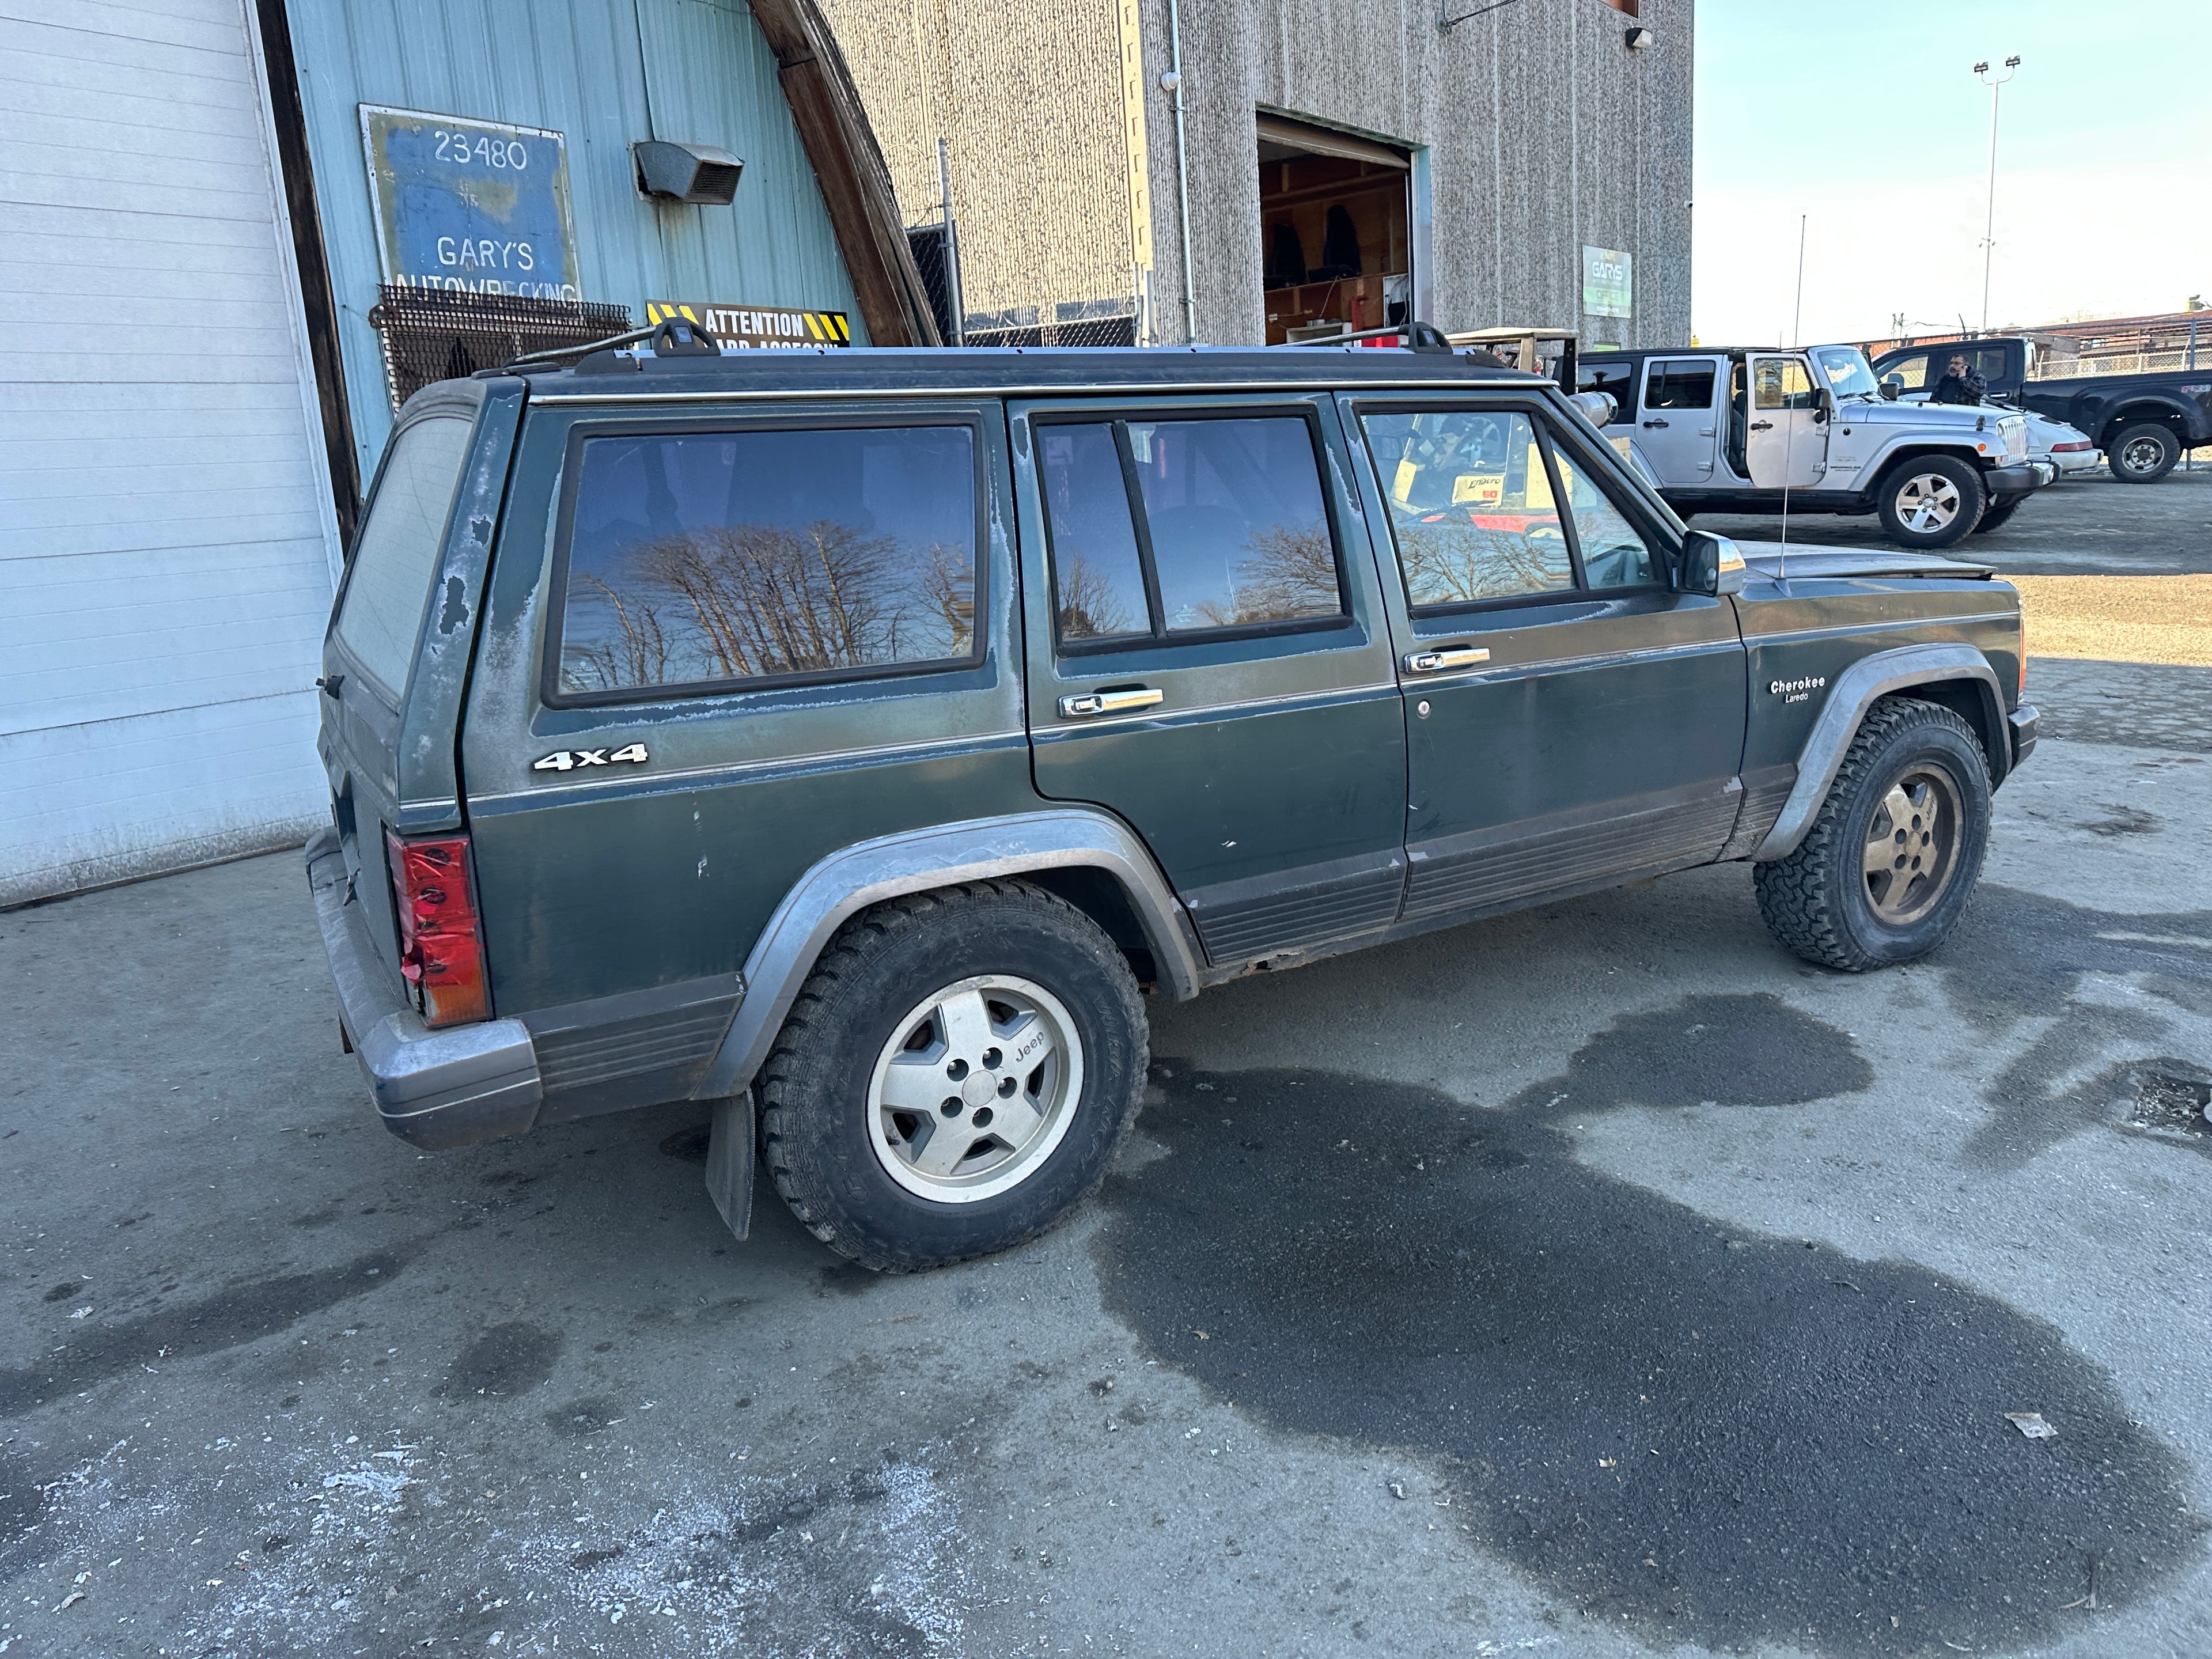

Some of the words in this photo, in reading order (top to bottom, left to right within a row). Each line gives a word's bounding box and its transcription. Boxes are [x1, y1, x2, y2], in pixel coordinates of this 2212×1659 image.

[434, 130, 527, 170] 23480
[437, 236, 533, 270] GARY'S
[1592, 261, 1623, 281] GARYS
[706, 309, 804, 336] ATTENTION
[1771, 676, 1825, 694] Cherokee
[1785, 692, 1808, 703] Laredo
[1926, 795, 1935, 821] Jeep
[1016, 1032, 1044, 1062] Jeep
